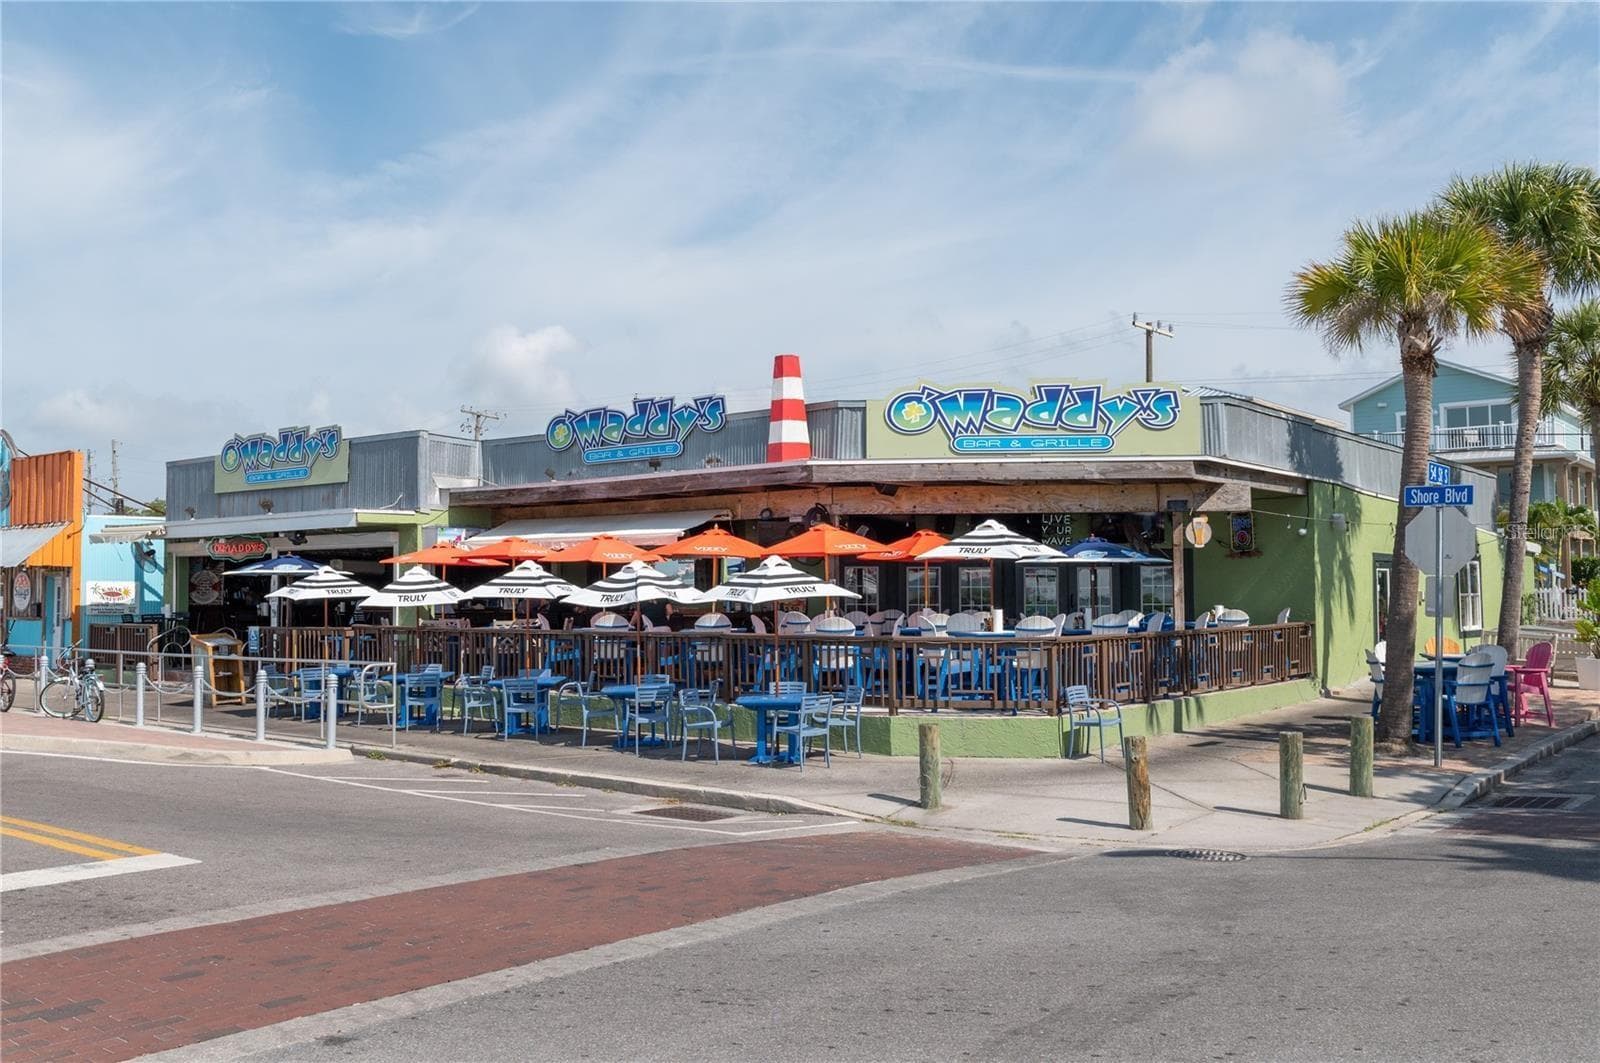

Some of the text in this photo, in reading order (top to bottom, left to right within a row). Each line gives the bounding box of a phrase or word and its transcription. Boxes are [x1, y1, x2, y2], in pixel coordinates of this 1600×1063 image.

[963, 438, 1103, 448] BAR & GRILLE
[589, 446, 675, 461] BAR & GRILLE
[1430, 464, 1437, 481] 54
[1410, 487, 1468, 504] Shore Blvd
[1042, 513, 1072, 525] LIVE
[1042, 536, 1072, 547] WAVE
[726, 588, 747, 597] TRULY
[784, 585, 817, 594] TRULY
[397, 593, 427, 603] TRULY
[600, 593, 626, 603] TRULY
